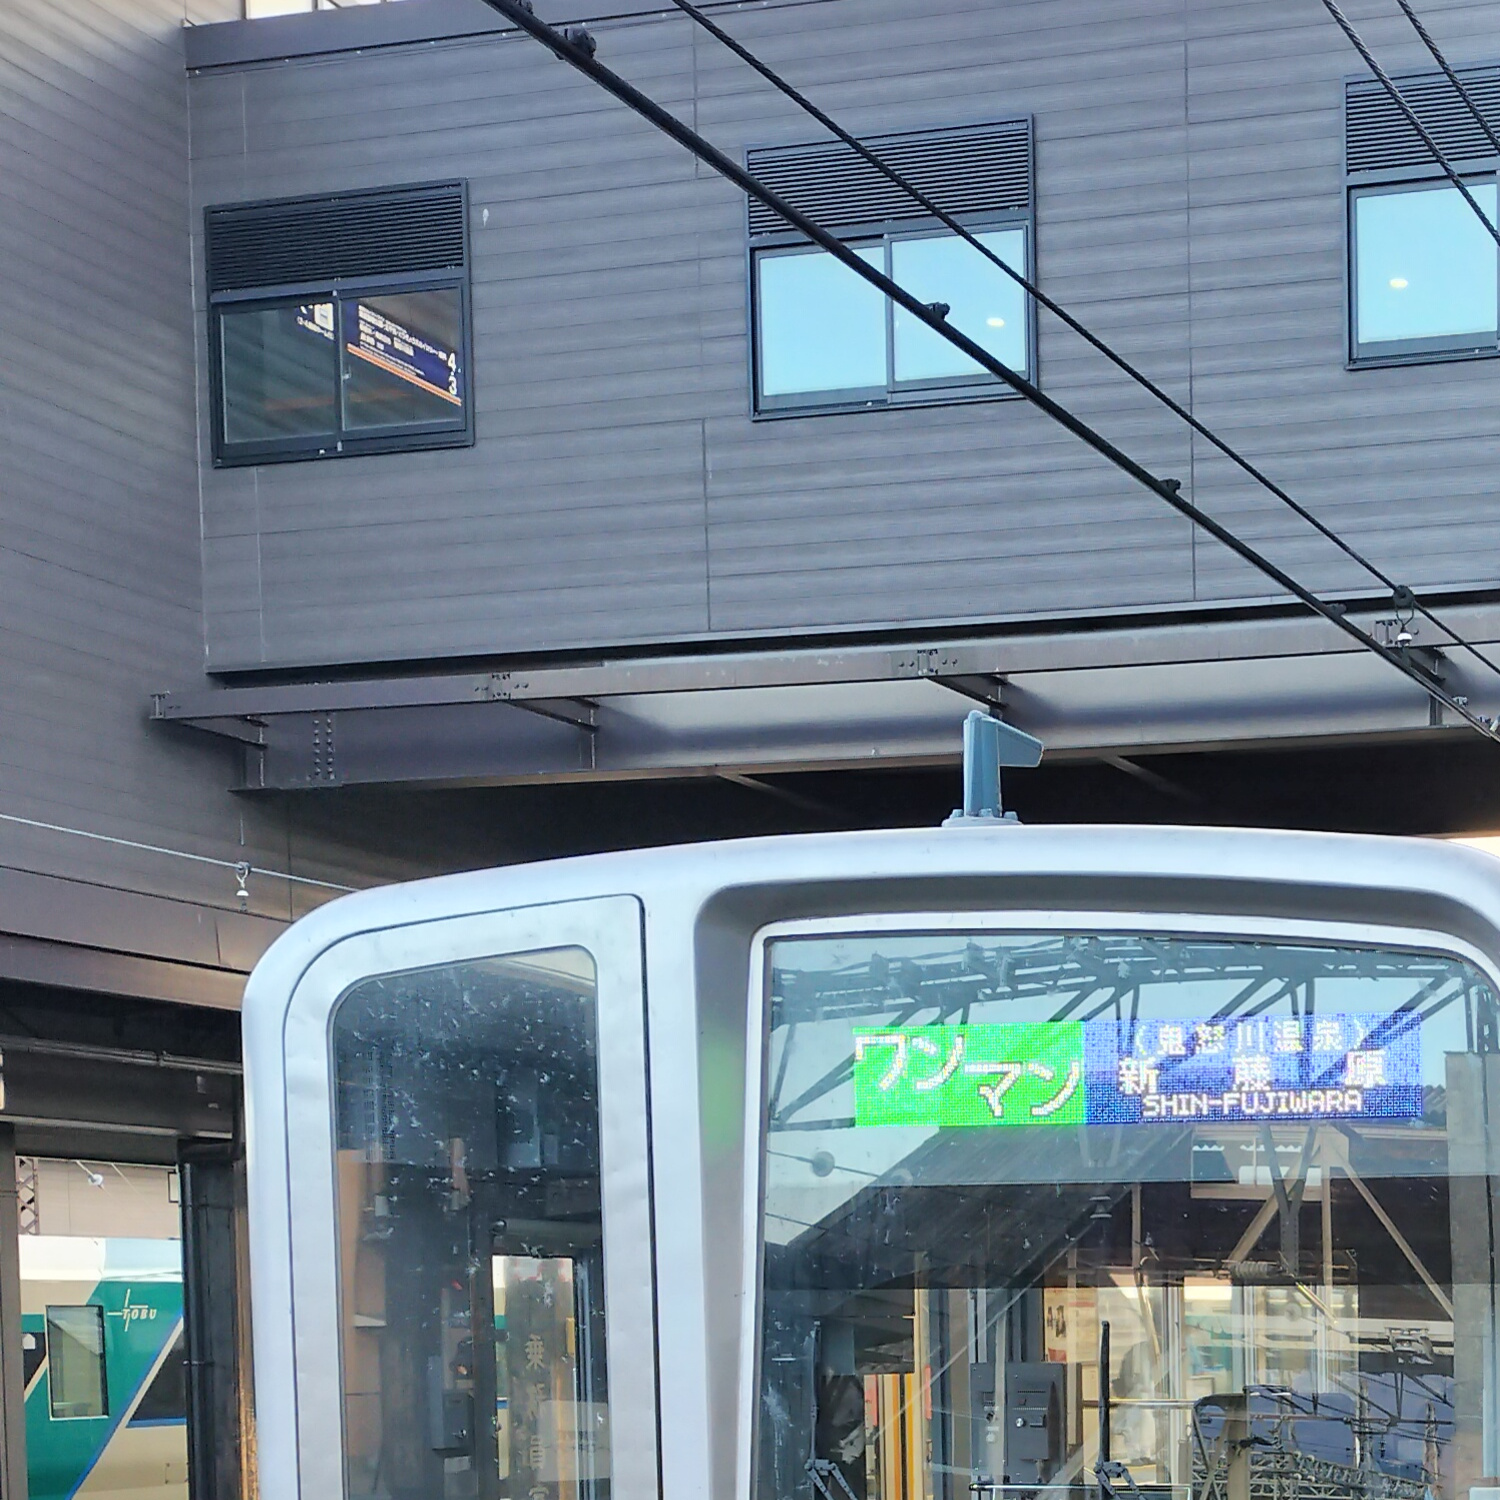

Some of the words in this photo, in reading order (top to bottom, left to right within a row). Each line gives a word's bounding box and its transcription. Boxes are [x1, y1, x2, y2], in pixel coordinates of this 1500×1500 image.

[855, 1033, 1081, 1118] ワンマン
[1118, 1049, 1388, 1095] 新藤原
[1142, 1090, 1363, 1117] SHIN-FUJIWARA
[121, 1308, 157, 1320] TOBU
